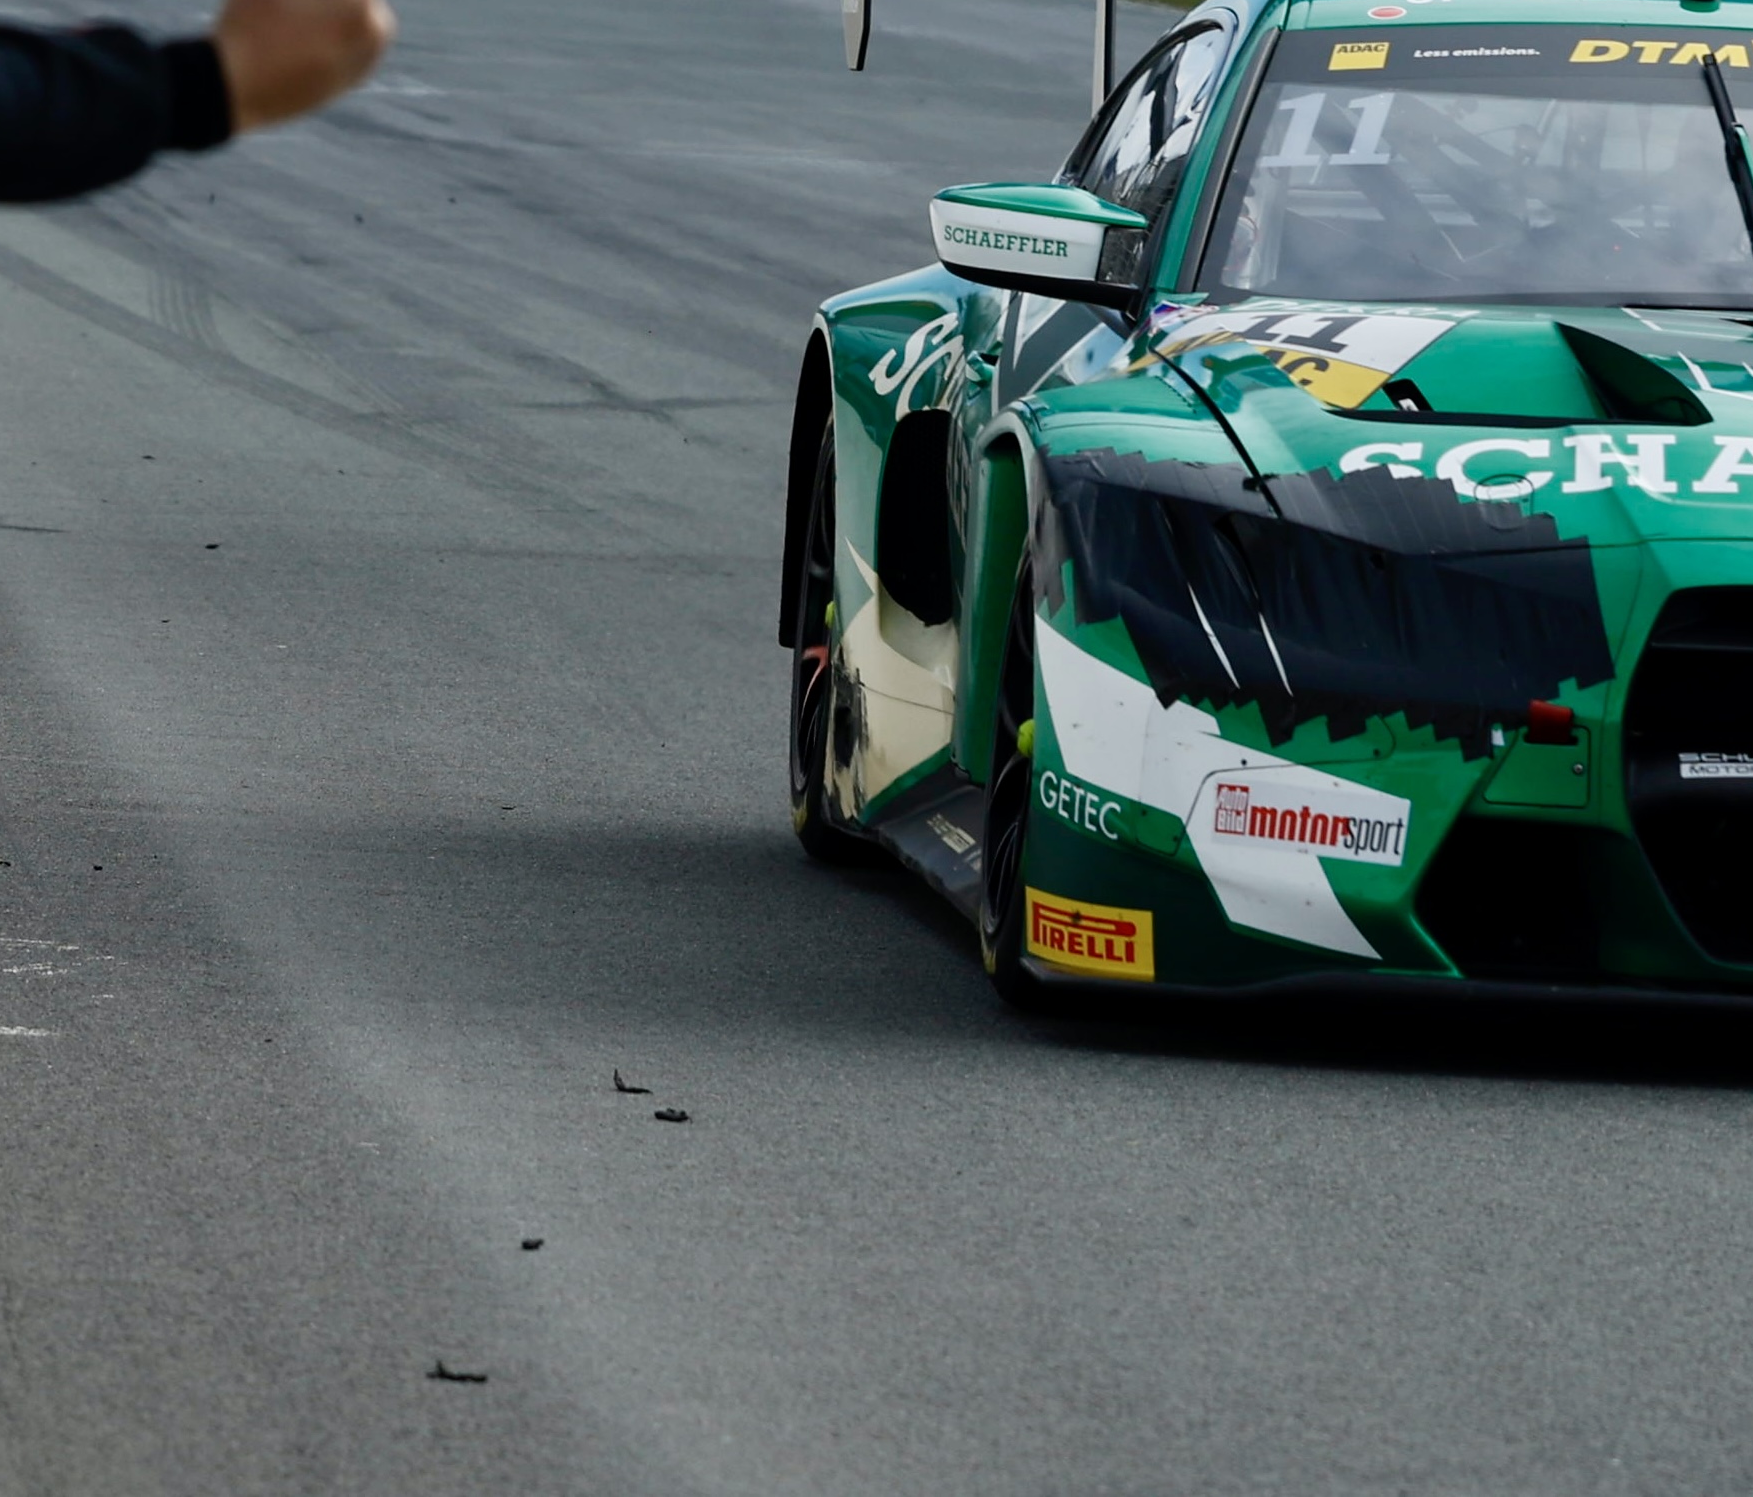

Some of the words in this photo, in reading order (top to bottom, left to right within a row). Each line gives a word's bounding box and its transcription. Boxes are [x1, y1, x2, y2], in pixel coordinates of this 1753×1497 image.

[1336, 42, 1386, 54] ADAC
[1413, 48, 1450, 59] Less
[1452, 46, 1541, 58] emissions.
[1568, 39, 1750, 68] DTM
[1257, 92, 1396, 168] 11
[943, 225, 1068, 258] SCHAEFFLER
[1224, 313, 1369, 353] 11
[1039, 770, 1122, 841] GETEC
[1217, 785, 1248, 811] Auto
[1215, 808, 1246, 834] Bild
[1248, 803, 1405, 857] motorsport
[1031, 900, 1137, 964] PIRELLI
